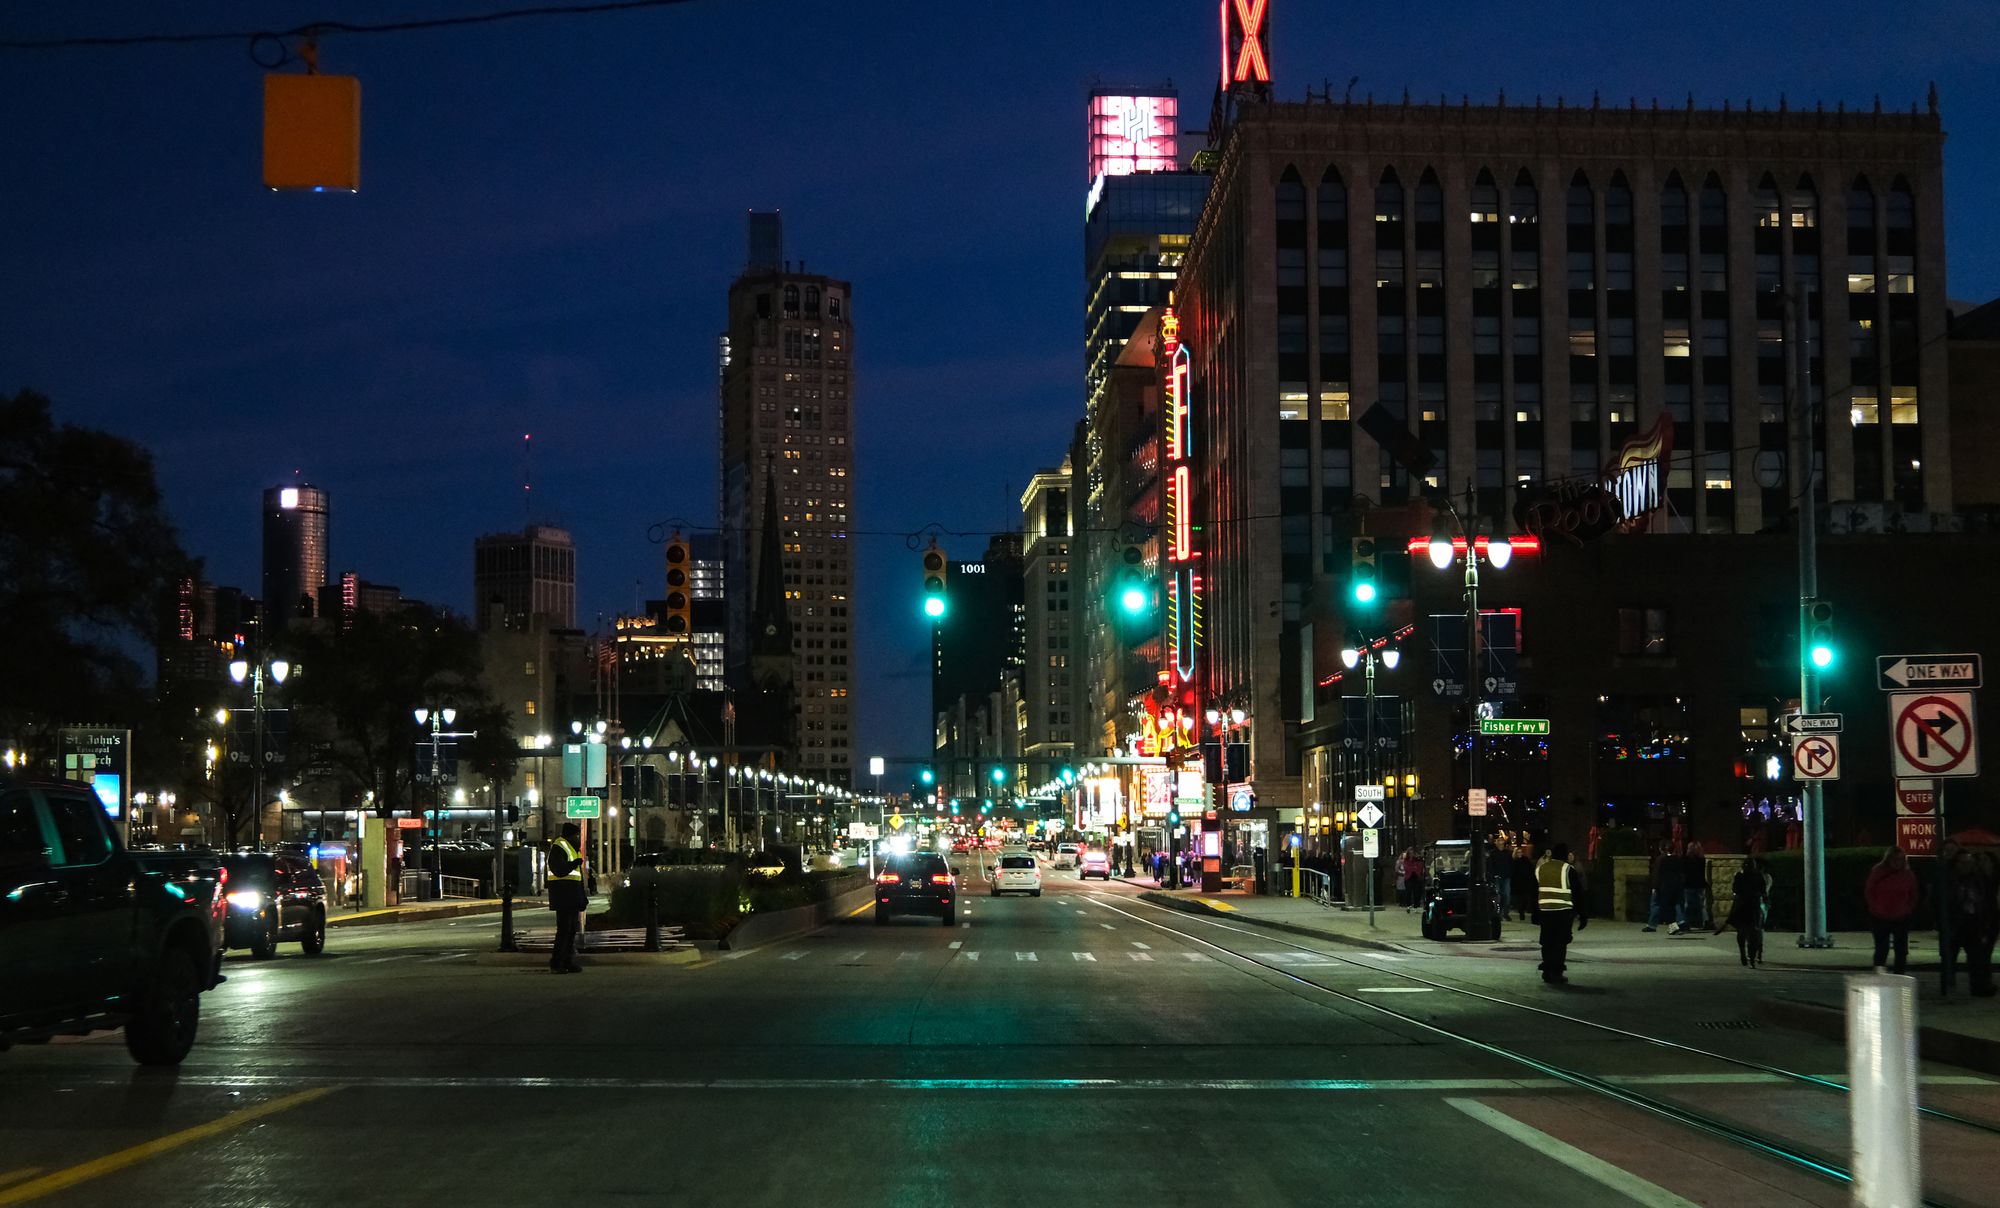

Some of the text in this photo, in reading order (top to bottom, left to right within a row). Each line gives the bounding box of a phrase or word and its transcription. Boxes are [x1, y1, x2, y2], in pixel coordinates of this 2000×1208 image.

[960, 563, 986, 574] 1001
[1906, 665, 1970, 679] ONE WAY
[1484, 721, 1546, 733] Fisher Fwy W
[1820, 719, 1836, 727] WAY
[87, 734, 121, 747] John's
[1357, 788, 1382, 798] SOUTH
[1905, 793, 1934, 803] ENTER
[1909, 839, 1932, 850] WAY
